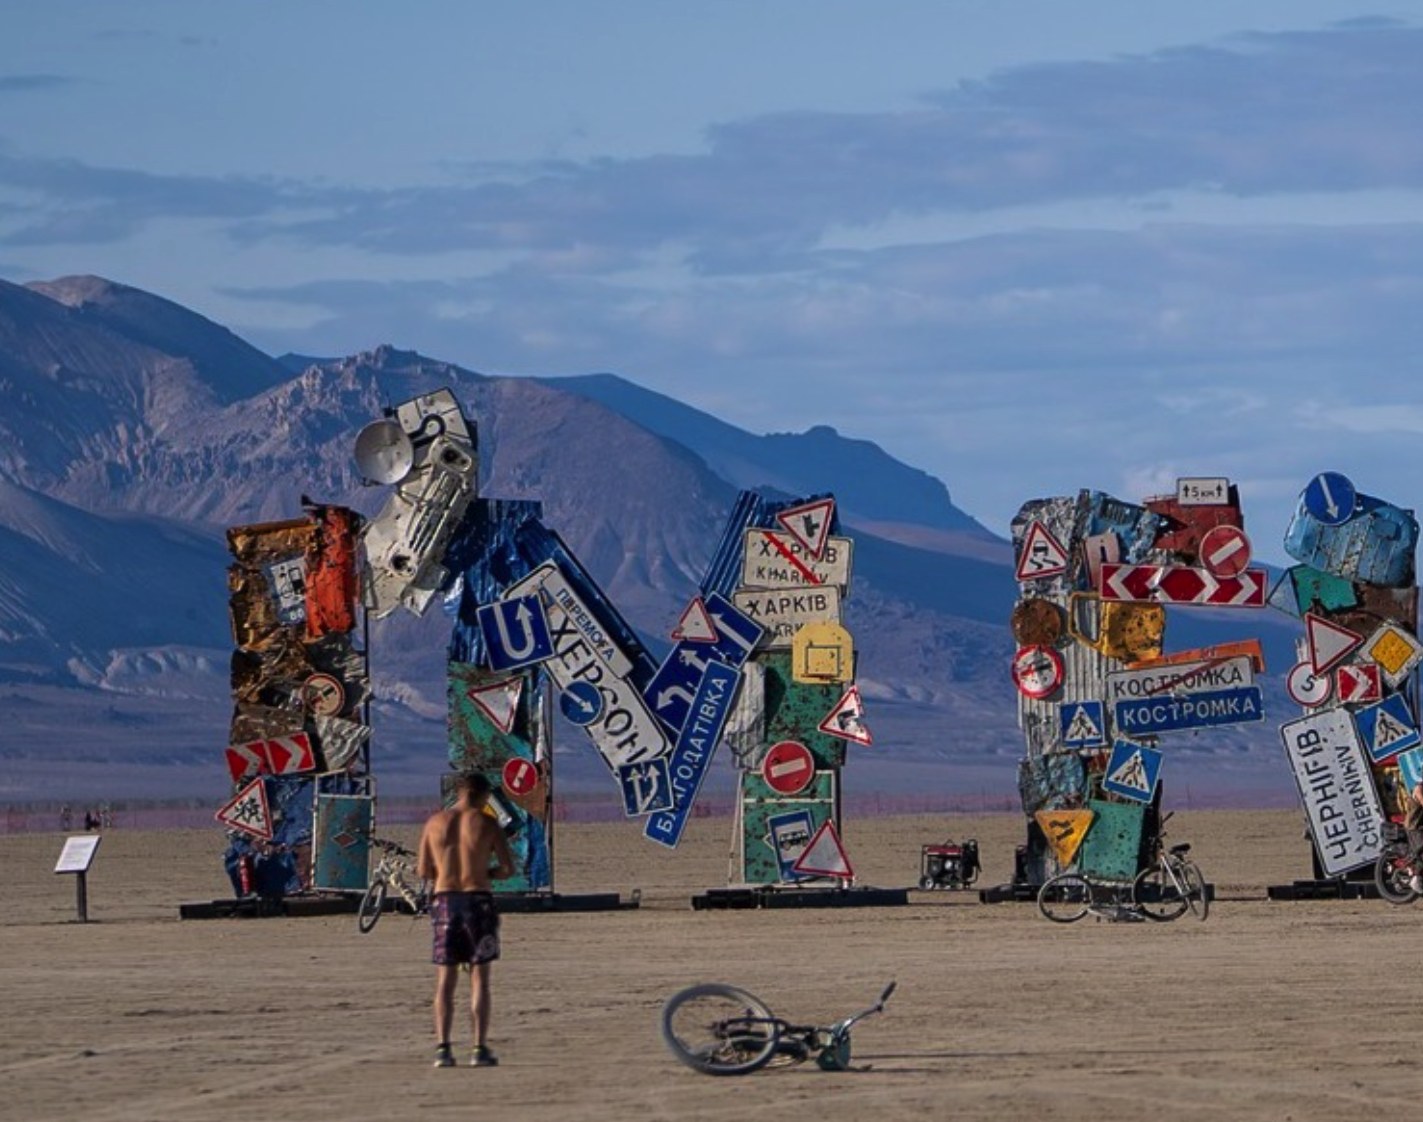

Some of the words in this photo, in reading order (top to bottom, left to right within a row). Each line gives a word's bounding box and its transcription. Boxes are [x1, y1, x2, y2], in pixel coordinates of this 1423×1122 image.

[1192, 486, 1199, 498] 5
[759, 541, 838, 564] ХАРВ
[756, 566, 829, 584] KHARV
[745, 594, 827, 617] ХАРКІВ
[1113, 666, 1243, 698] КОСТРОМКА
[1123, 697, 1256, 727] КОСТРОМКА
[1296, 727, 1352, 860] ЧЕРНІГІВ
